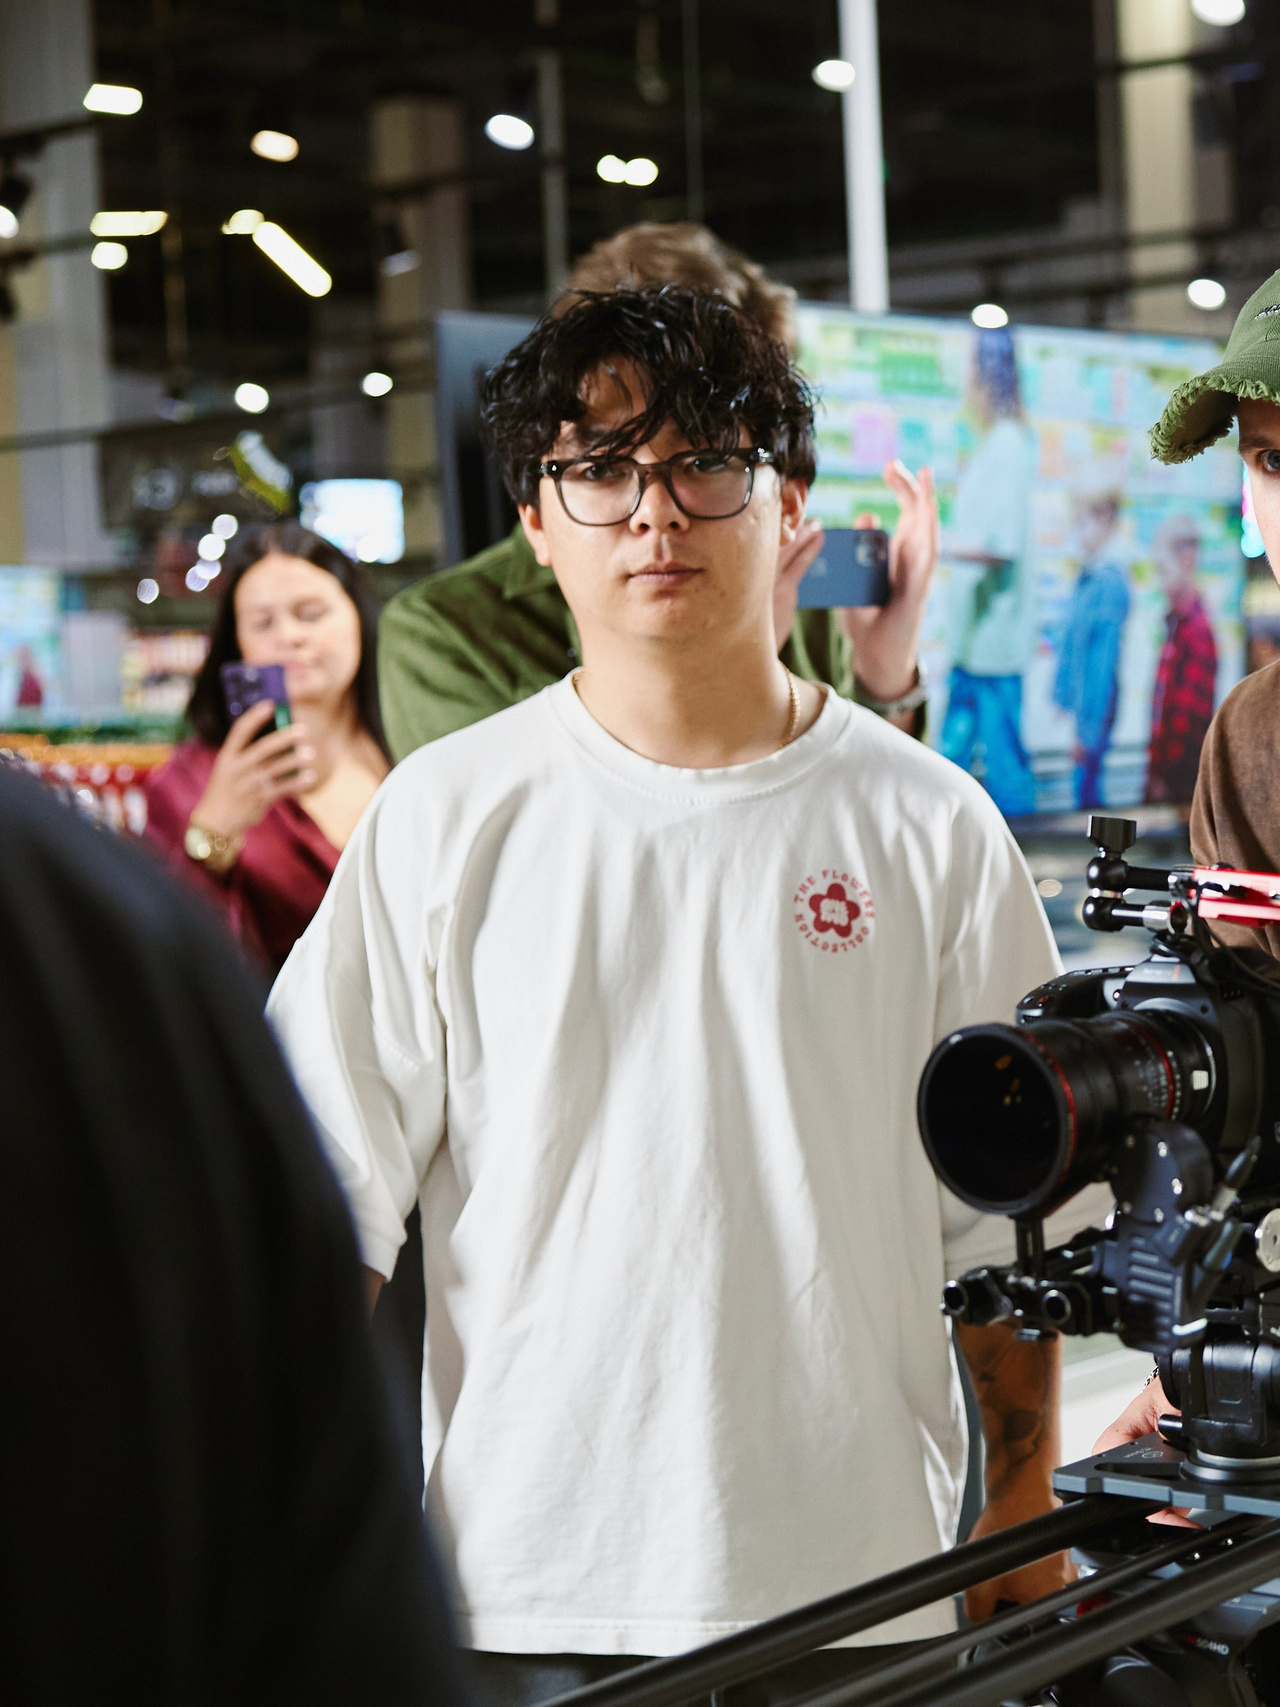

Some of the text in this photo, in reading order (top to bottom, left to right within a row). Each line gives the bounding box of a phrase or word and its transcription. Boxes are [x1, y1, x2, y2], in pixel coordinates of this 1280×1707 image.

[793, 869, 875, 954] THE FLOWERS COLLECTION
